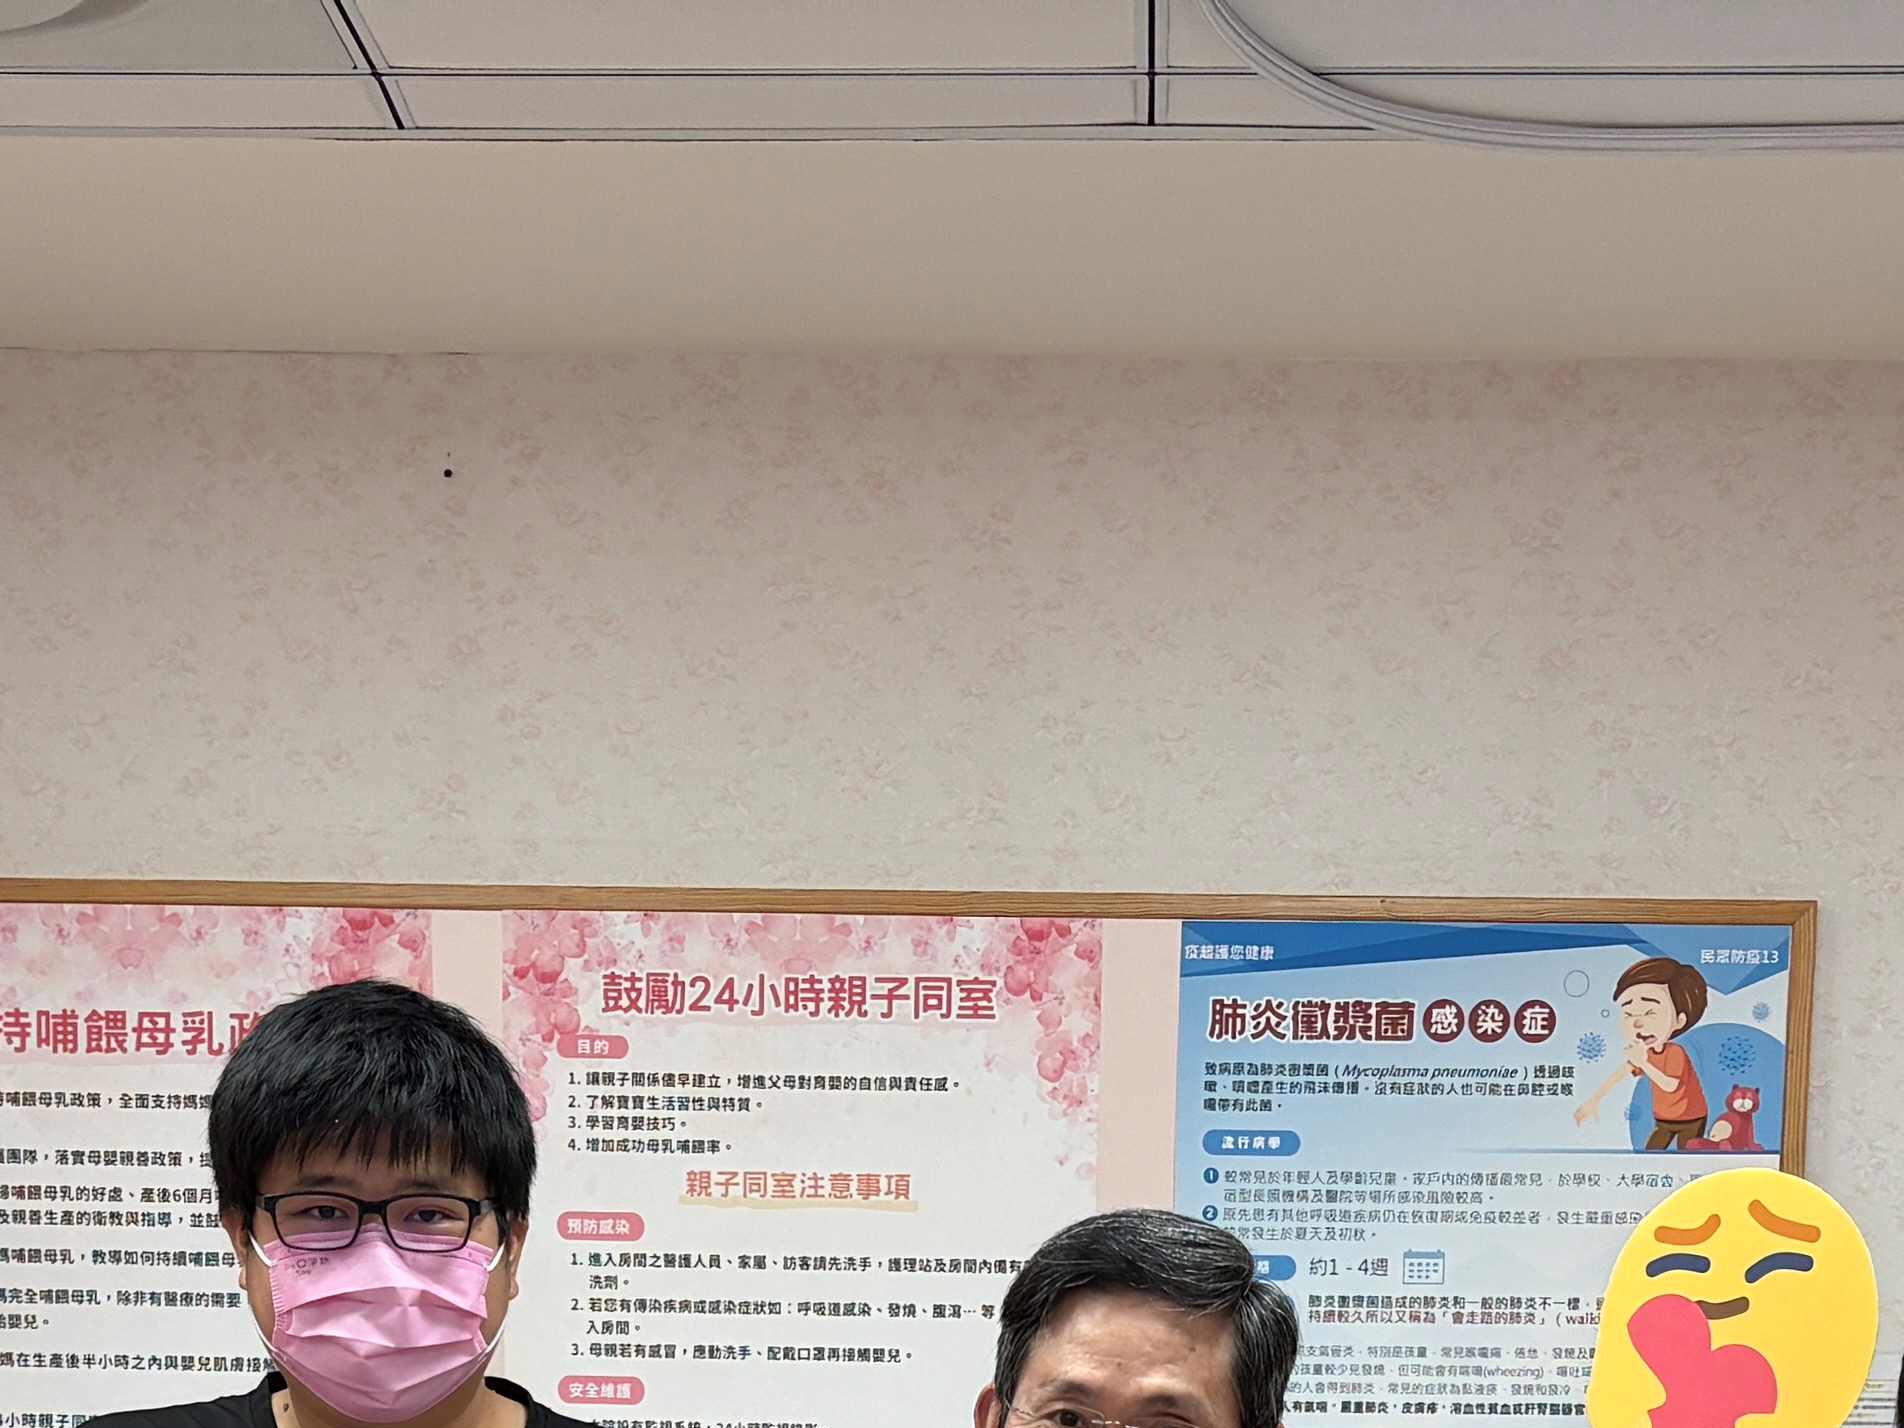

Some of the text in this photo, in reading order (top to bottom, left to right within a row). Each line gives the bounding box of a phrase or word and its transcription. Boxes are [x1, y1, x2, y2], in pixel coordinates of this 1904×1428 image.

[601, 972, 997, 1020] 鼓勵24小時親子同室
[577, 1039, 609, 1055] 目的
[569, 1073, 582, 1086] 1.
[568, 1095, 581, 1109] 2.
[568, 1115, 687, 1131] 3. 學習育嬰技巧。
[568, 1138, 581, 1152] 4.
[685, 1170, 912, 1200] 親子同室注意事項
[567, 1218, 630, 1235] 預防感染
[571, 1254, 584, 1266] 1.
[571, 1299, 583, 1311] 2.
[587, 1320, 641, 1336] 入房間。
[571, 1344, 583, 1357] 3.
[569, 1384, 632, 1399] 安全維護
